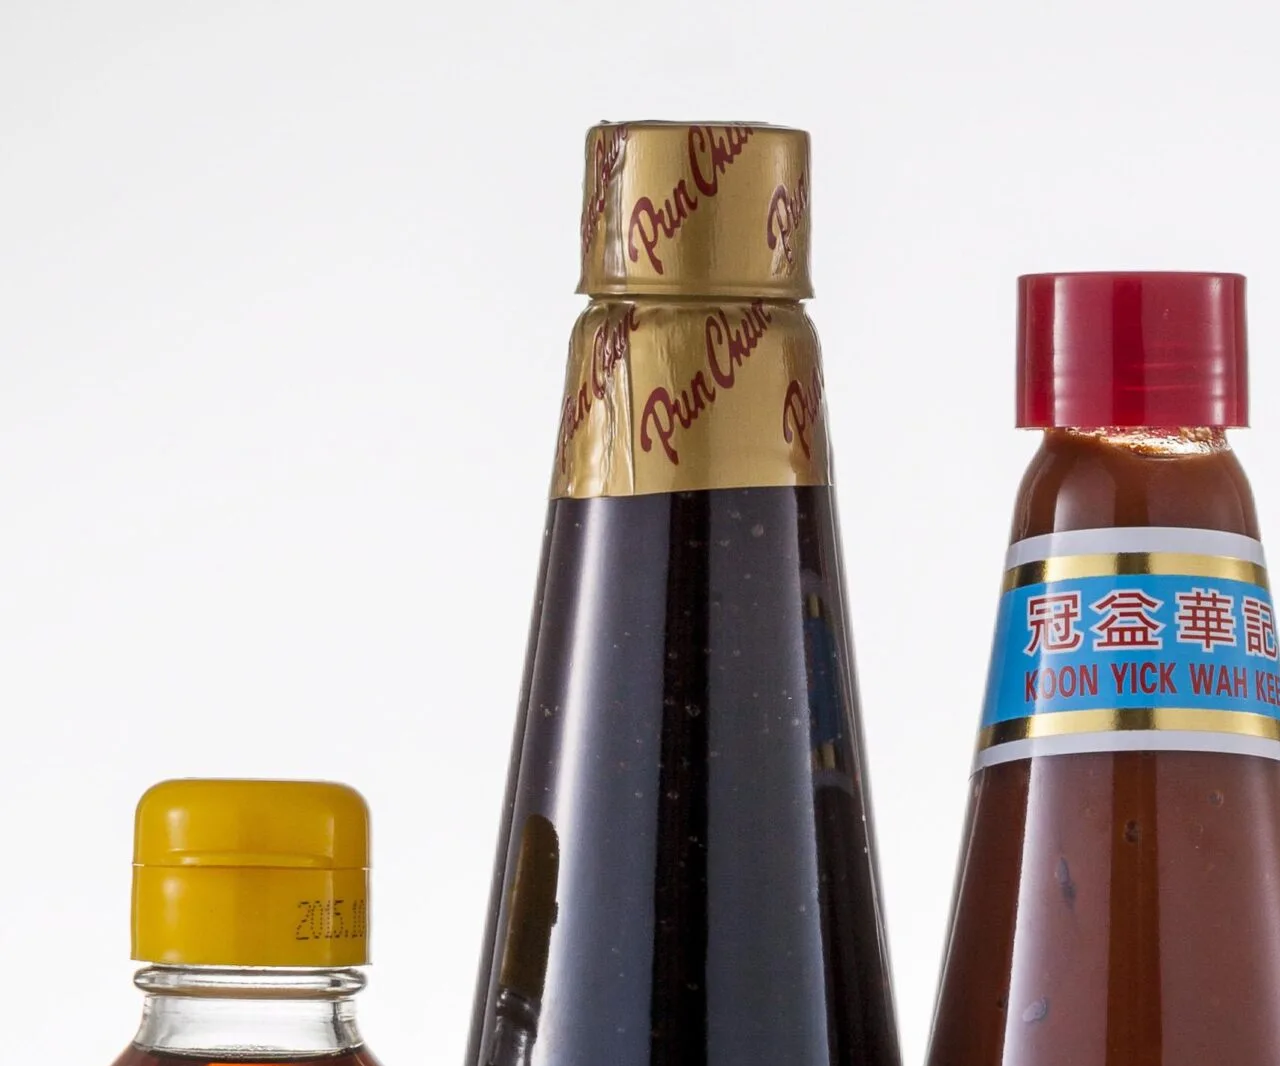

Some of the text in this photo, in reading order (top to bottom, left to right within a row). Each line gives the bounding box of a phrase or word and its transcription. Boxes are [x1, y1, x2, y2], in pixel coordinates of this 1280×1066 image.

[628, 179, 698, 275] Pun
[640, 300, 772, 465] Pun Chun
[1025, 664, 1098, 702] KOON
[1110, 662, 1177, 695] YICK
[1188, 664, 1248, 698] WAH
